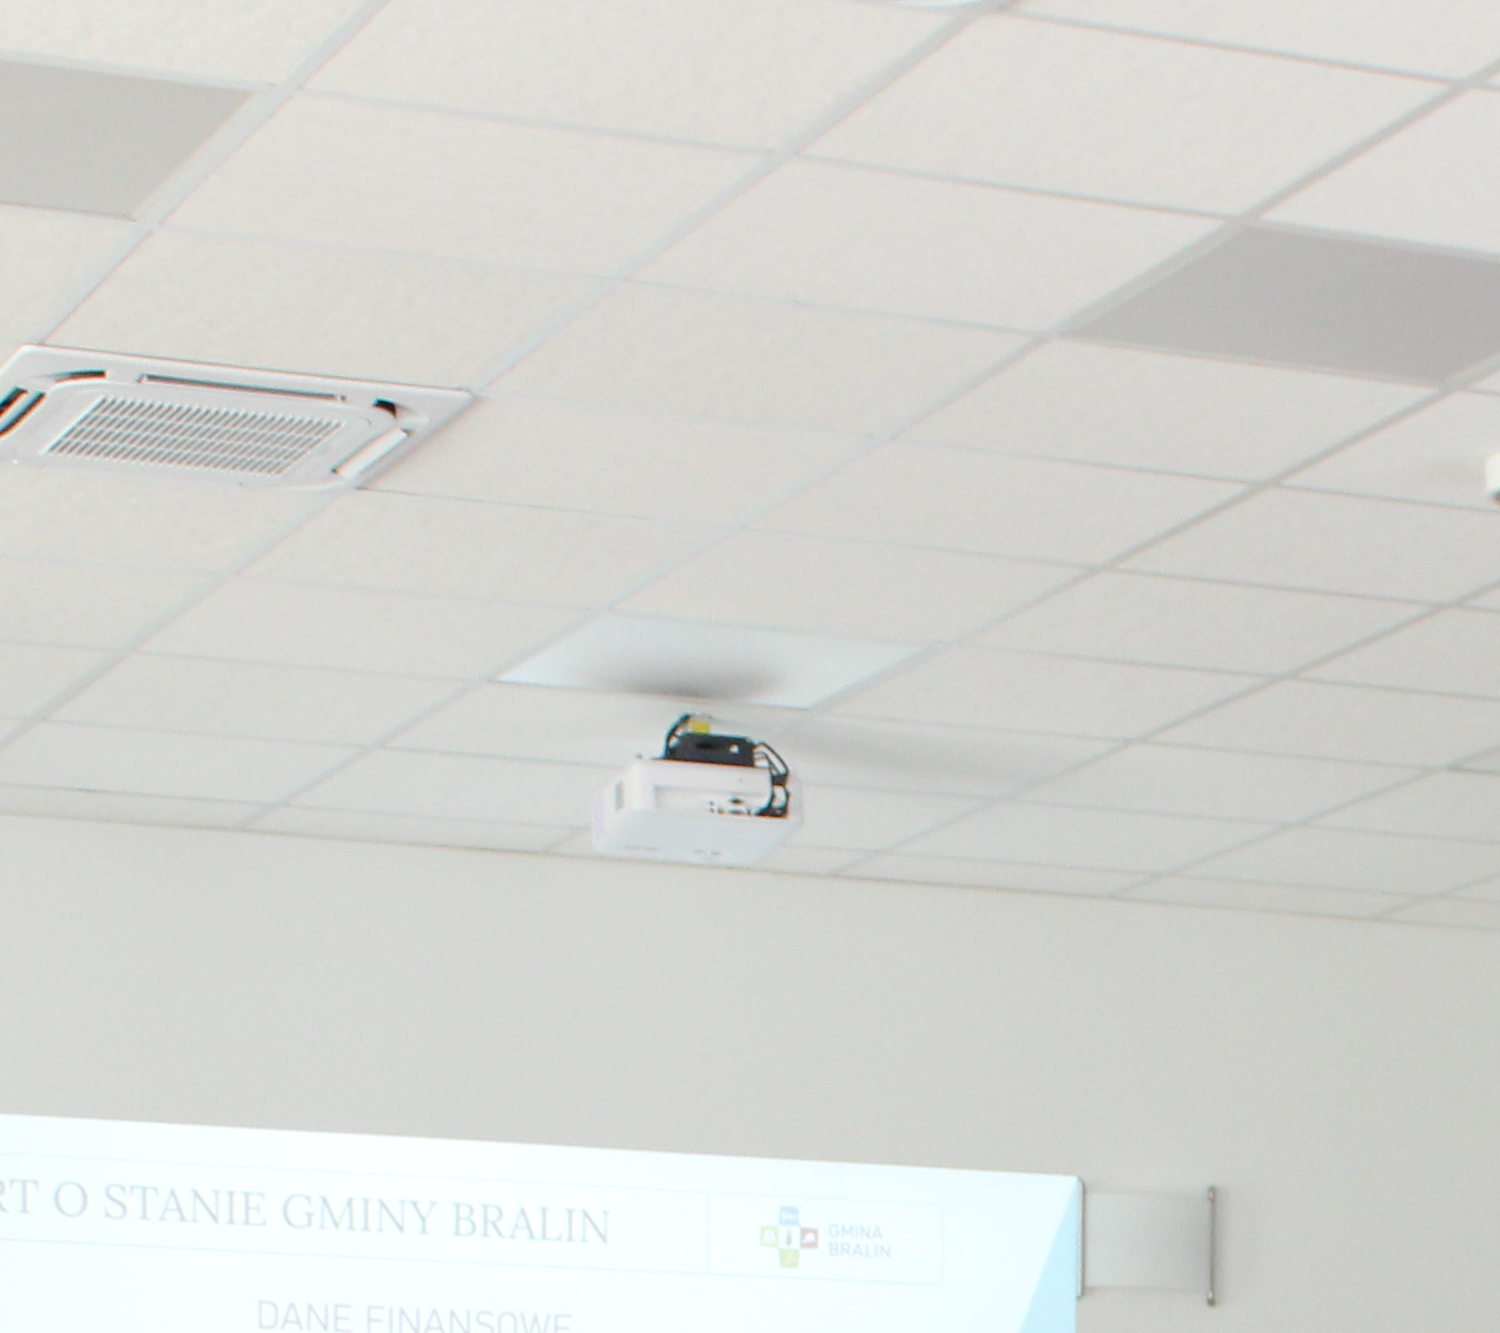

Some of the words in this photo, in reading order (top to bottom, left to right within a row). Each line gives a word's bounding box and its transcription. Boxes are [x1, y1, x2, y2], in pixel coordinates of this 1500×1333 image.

[52, 1181, 88, 1218] O
[103, 1183, 268, 1228] STANIE
[282, 1193, 437, 1237] GMINY
[454, 1202, 612, 1245] BRALIN
[829, 1223, 883, 1239] GMINA
[828, 1242, 891, 1258] BRALIN
[258, 1300, 353, 1333] DANE
